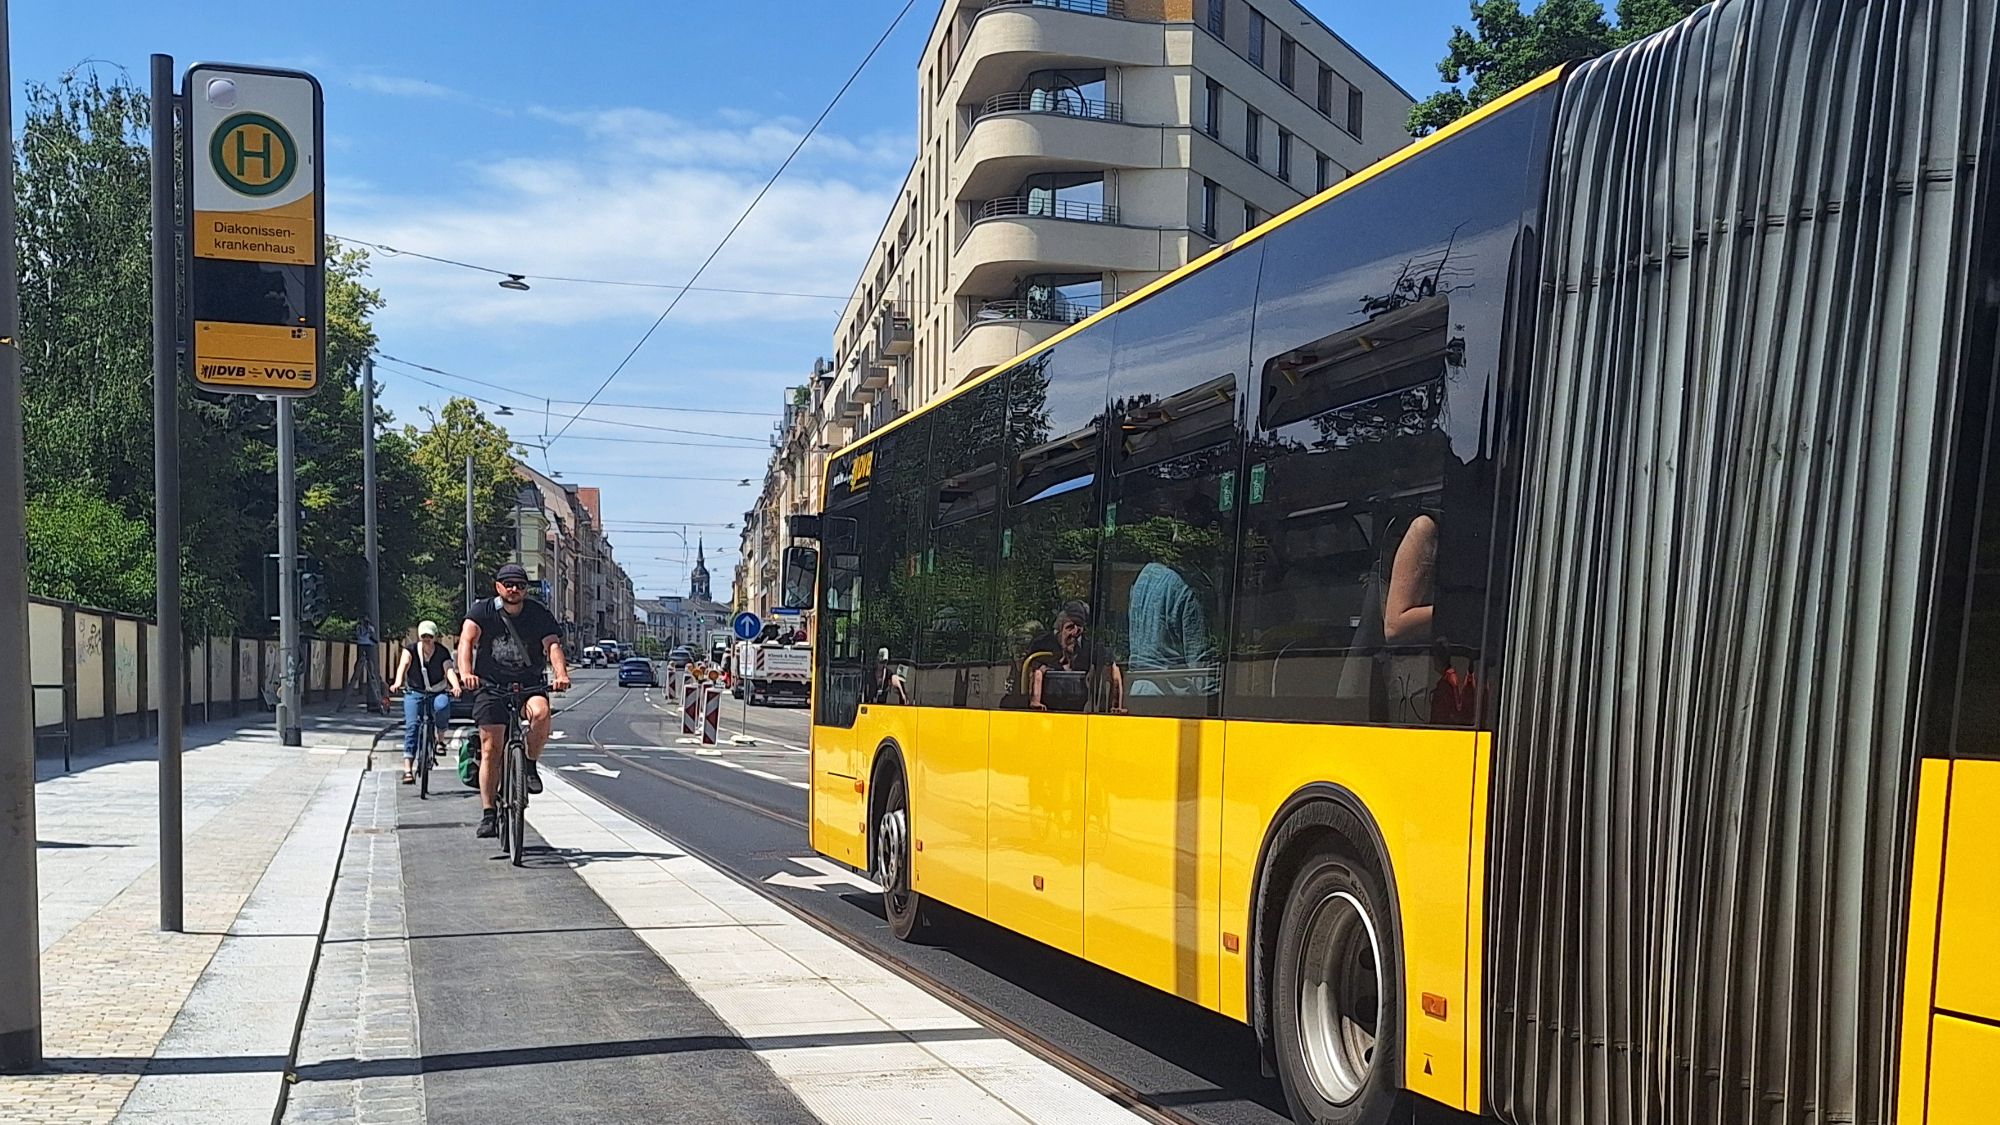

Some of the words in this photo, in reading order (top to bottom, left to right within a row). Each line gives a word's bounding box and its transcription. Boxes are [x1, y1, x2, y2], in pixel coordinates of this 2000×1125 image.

[236, 130, 271, 178] H
[214, 221, 296, 238] Diakonissen-
[214, 238, 296, 254] krankenhaus
[216, 365, 246, 377] DVB
[263, 367, 297, 380] VVO
